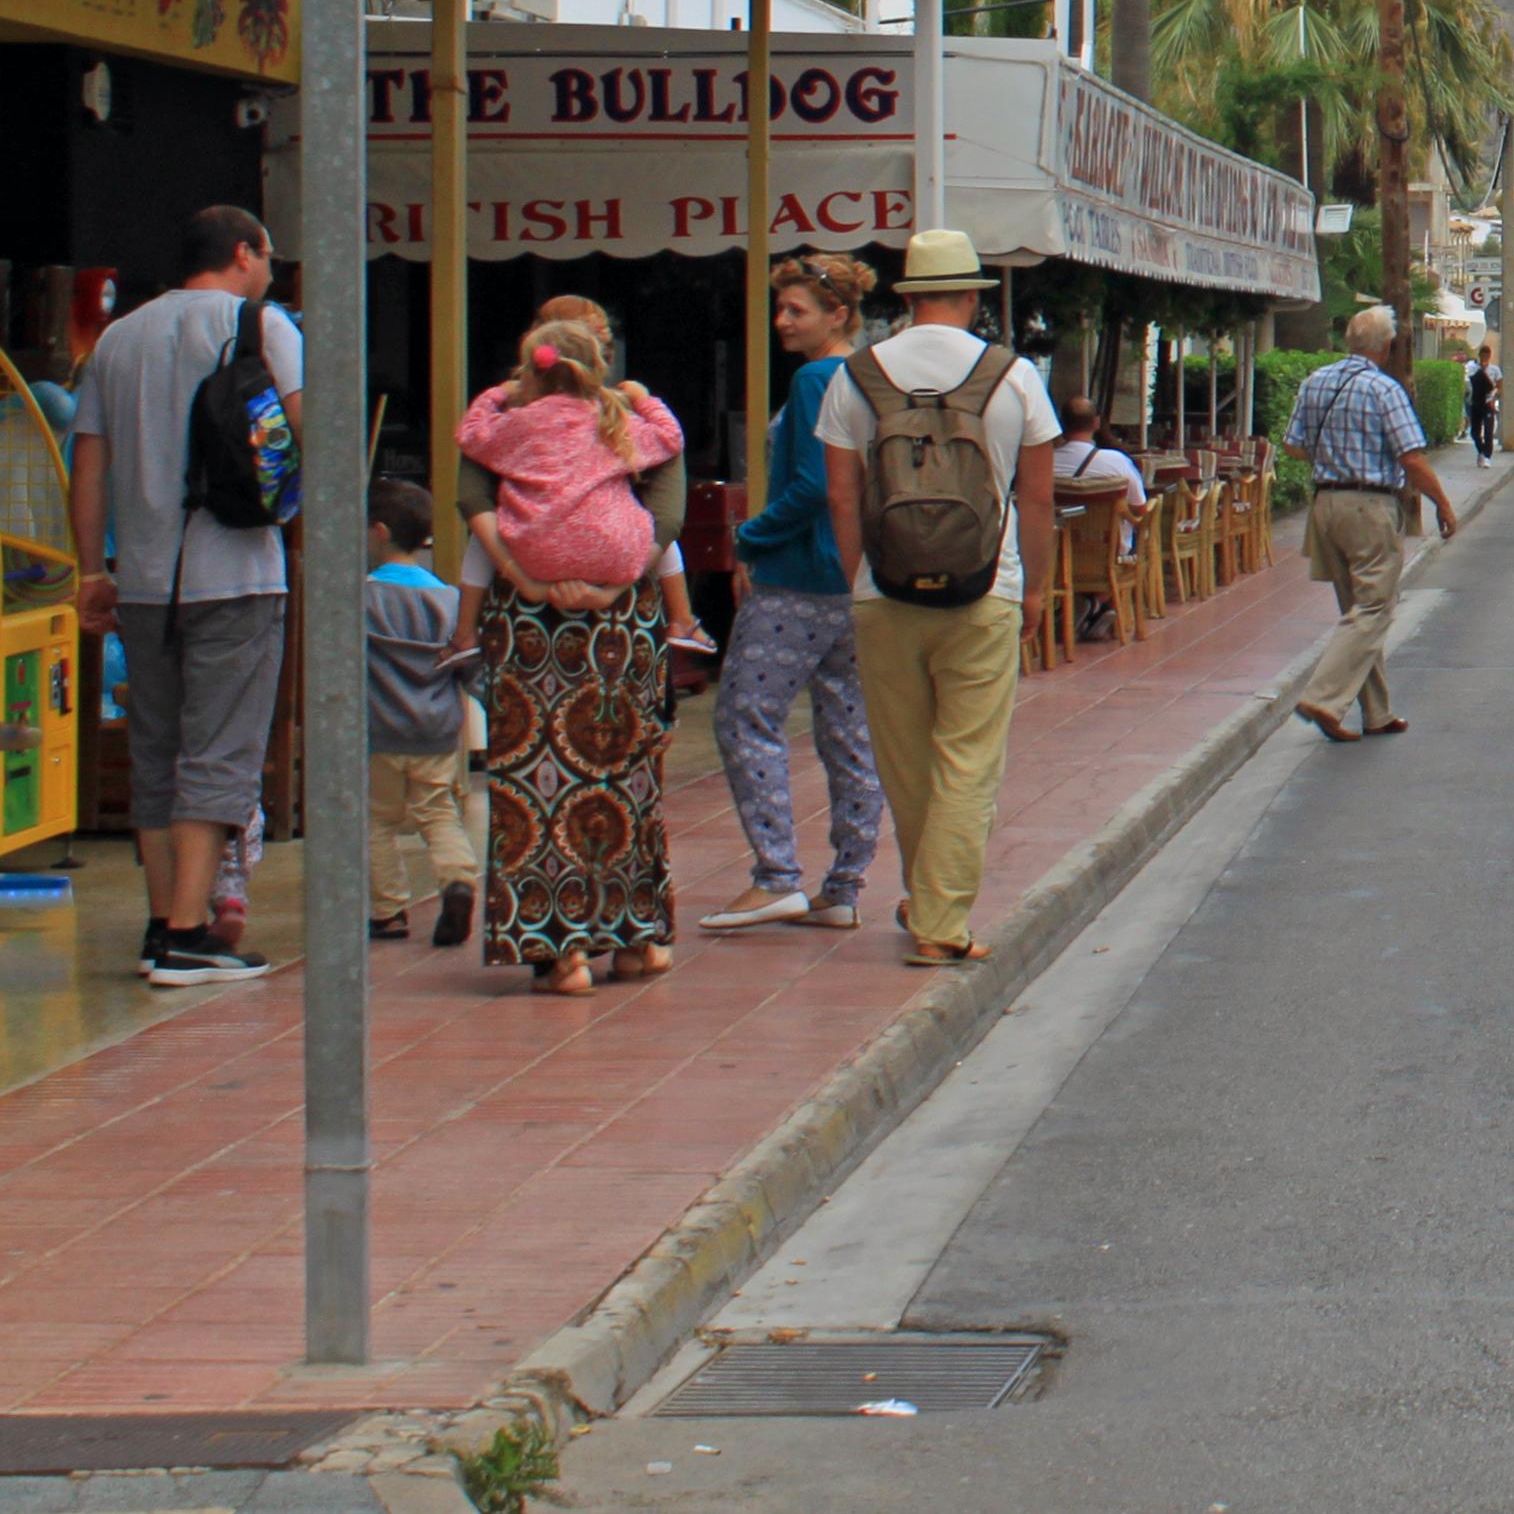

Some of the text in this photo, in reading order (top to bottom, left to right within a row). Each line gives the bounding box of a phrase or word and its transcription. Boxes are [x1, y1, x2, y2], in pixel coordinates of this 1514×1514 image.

[549, 66, 899, 124] BULLDOG
[366, 190, 915, 243] RIISH PLACE
